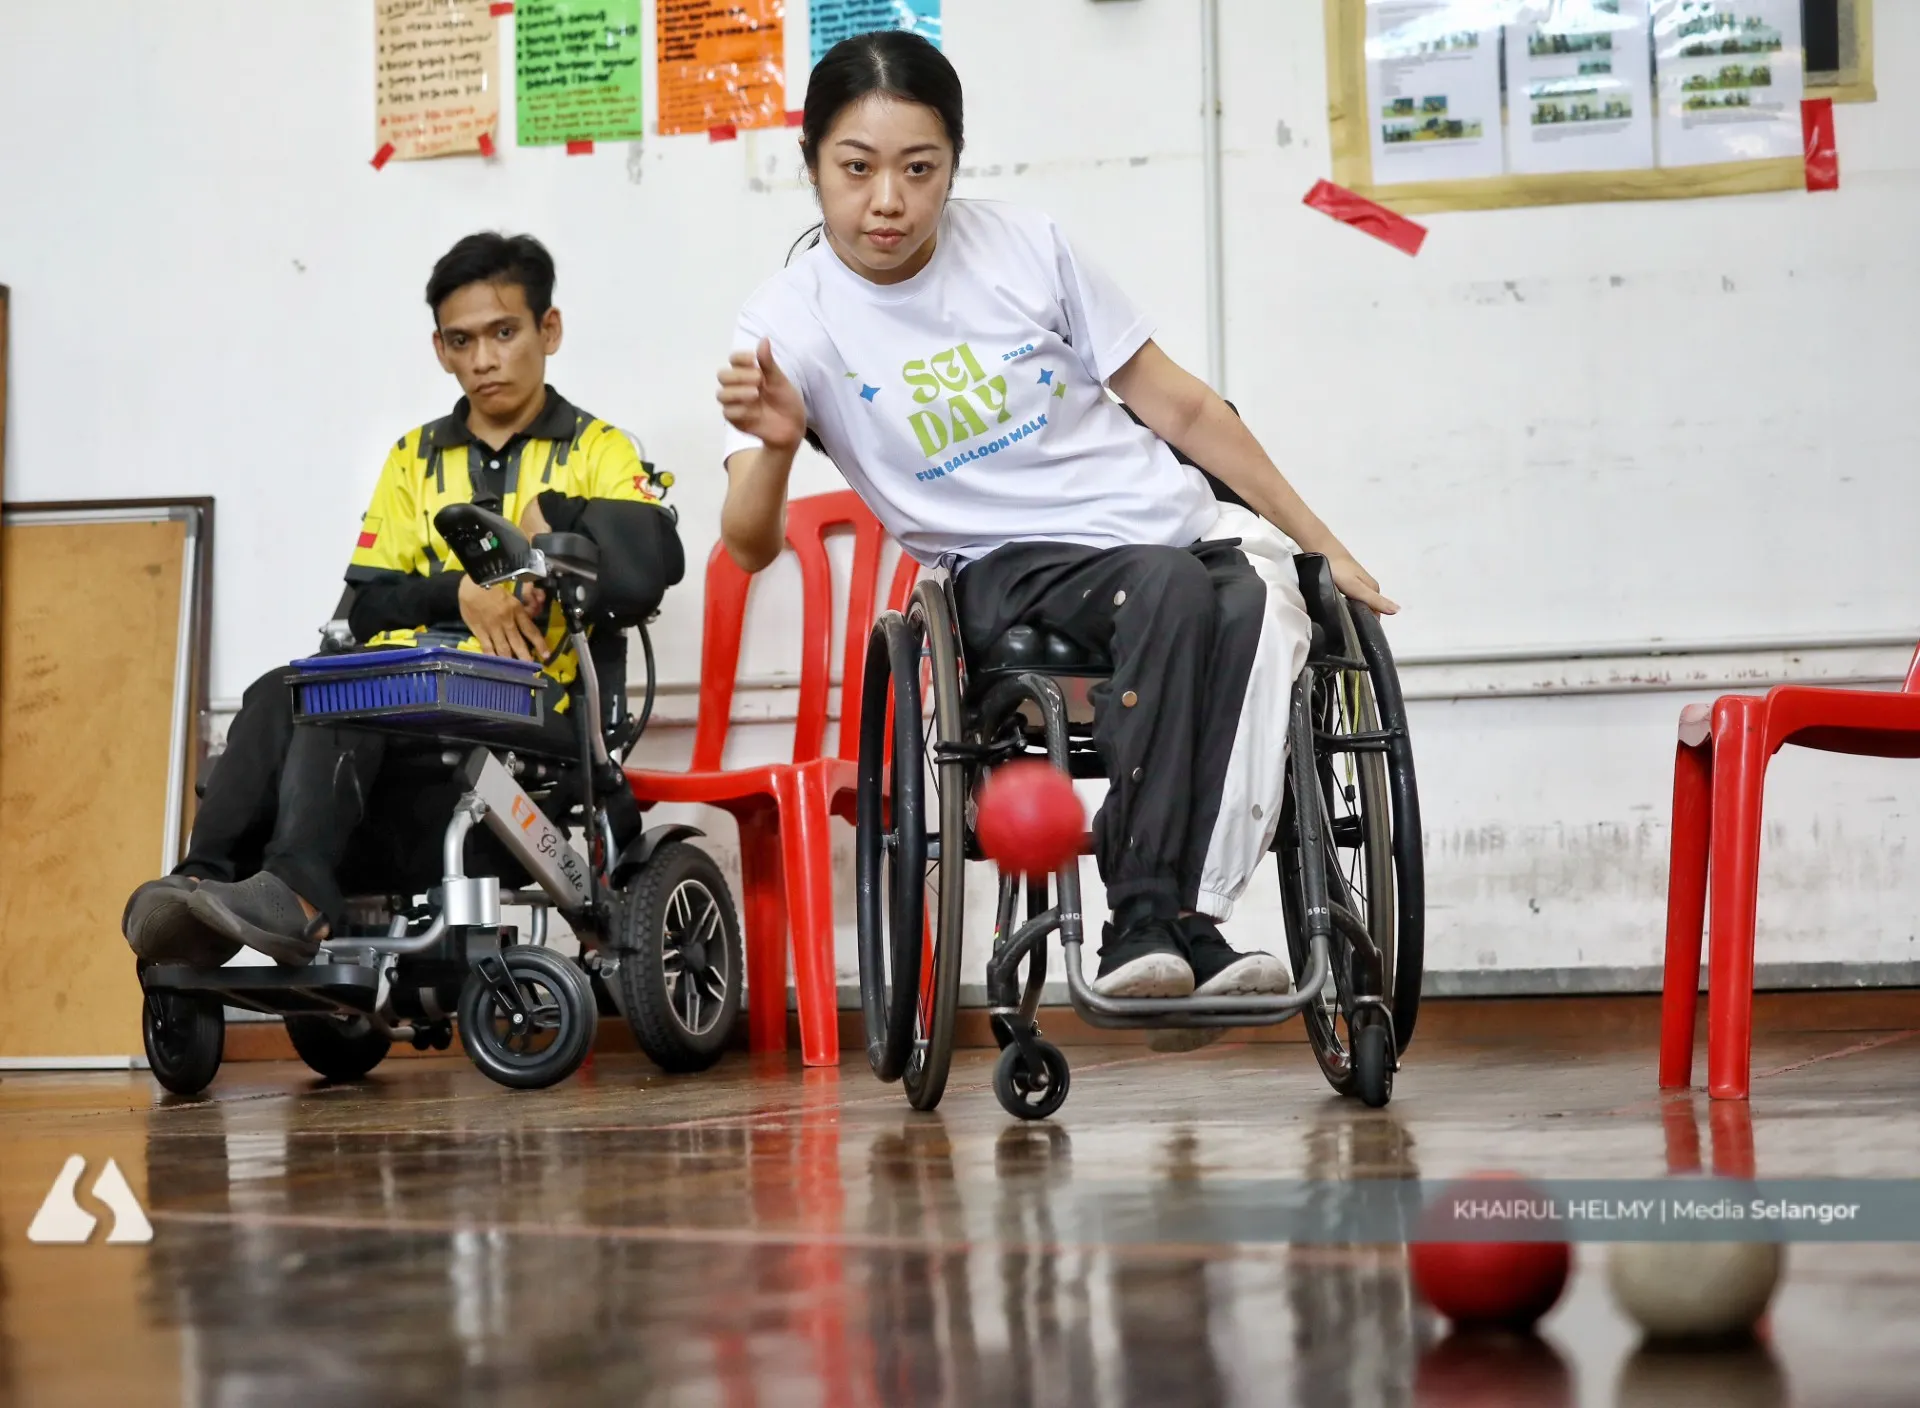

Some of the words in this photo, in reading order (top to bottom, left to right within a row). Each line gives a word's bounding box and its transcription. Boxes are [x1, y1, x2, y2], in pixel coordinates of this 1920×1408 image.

[902, 342, 987, 404] SCI
[907, 375, 1012, 458] DAY
[915, 466, 945, 482] FUN
[944, 436, 1010, 472] BALLOON
[1008, 413, 1049, 443] WALK
[537, 826, 557, 858] Go
[557, 854, 584, 892] Lite
